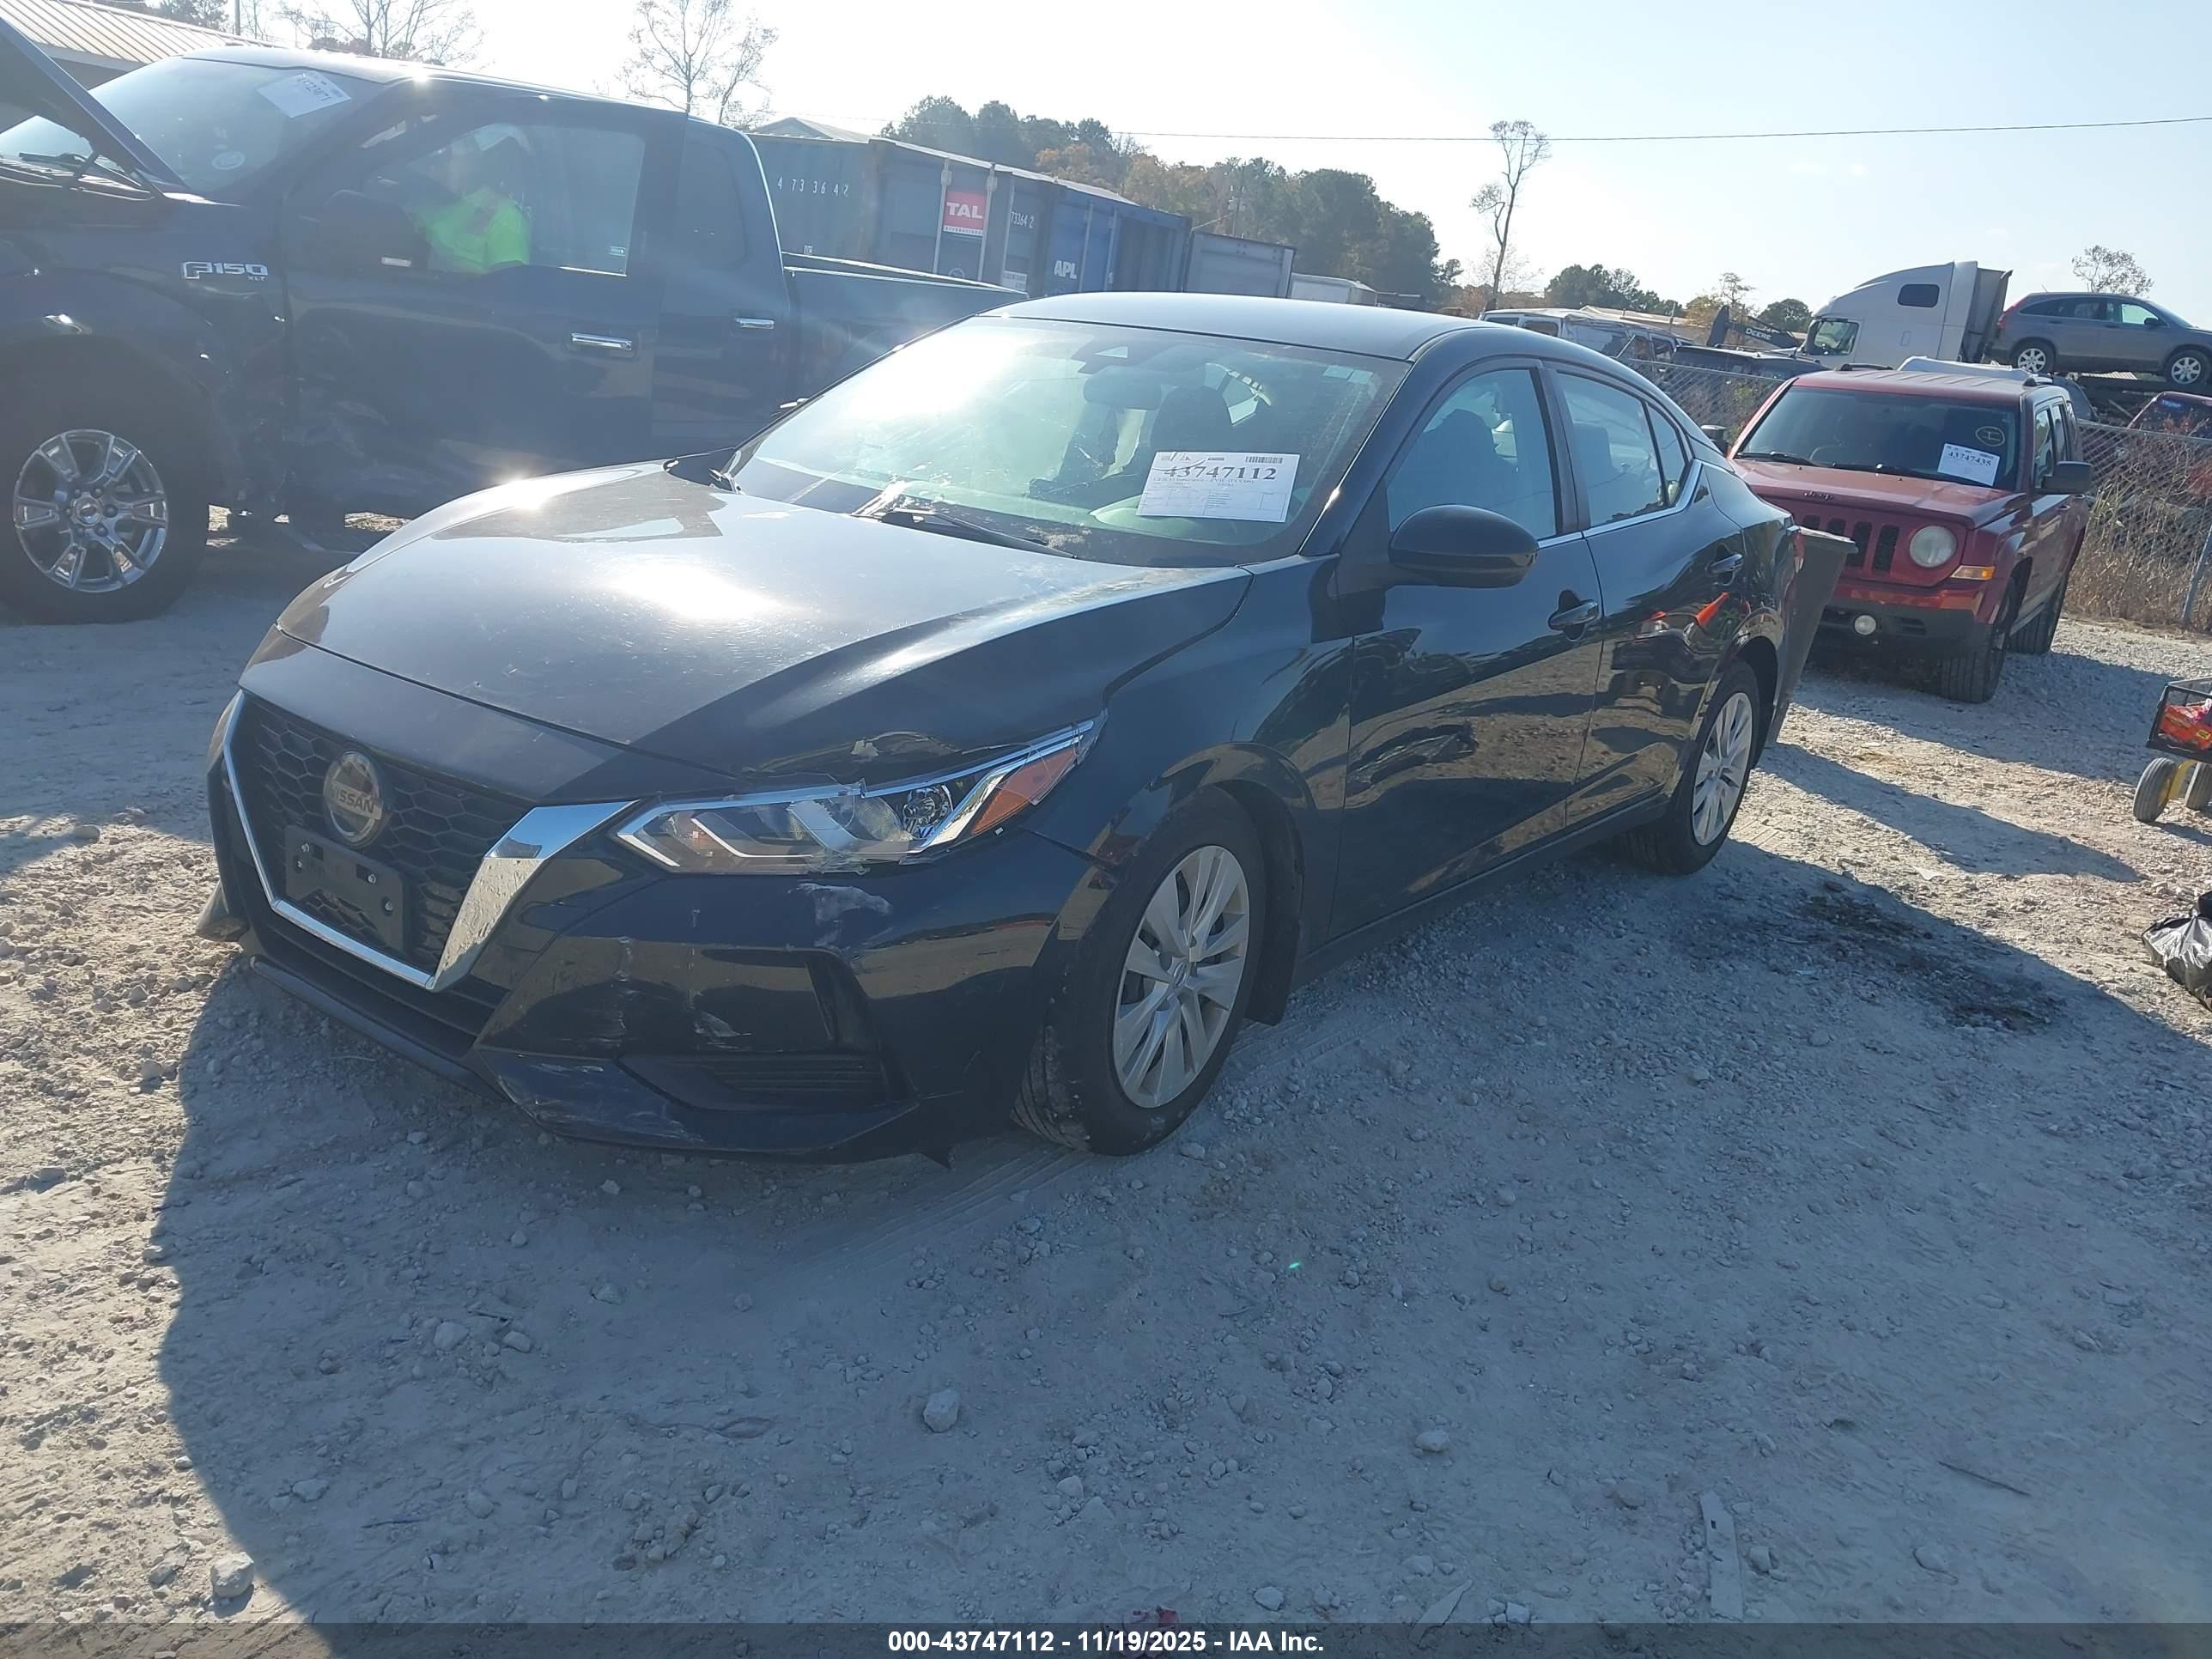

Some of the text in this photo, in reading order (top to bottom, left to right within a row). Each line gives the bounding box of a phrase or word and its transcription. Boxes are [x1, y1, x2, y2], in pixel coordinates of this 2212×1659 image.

[946, 202, 983, 220] TAL
[183, 261, 268, 280] F150
[1054, 260, 1078, 280] APL
[1745, 327, 1772, 341] DEERE
[1948, 451, 1992, 466] 43747435
[1164, 465, 1278, 480] 43747112
[330, 780, 374, 815] NISSAN
